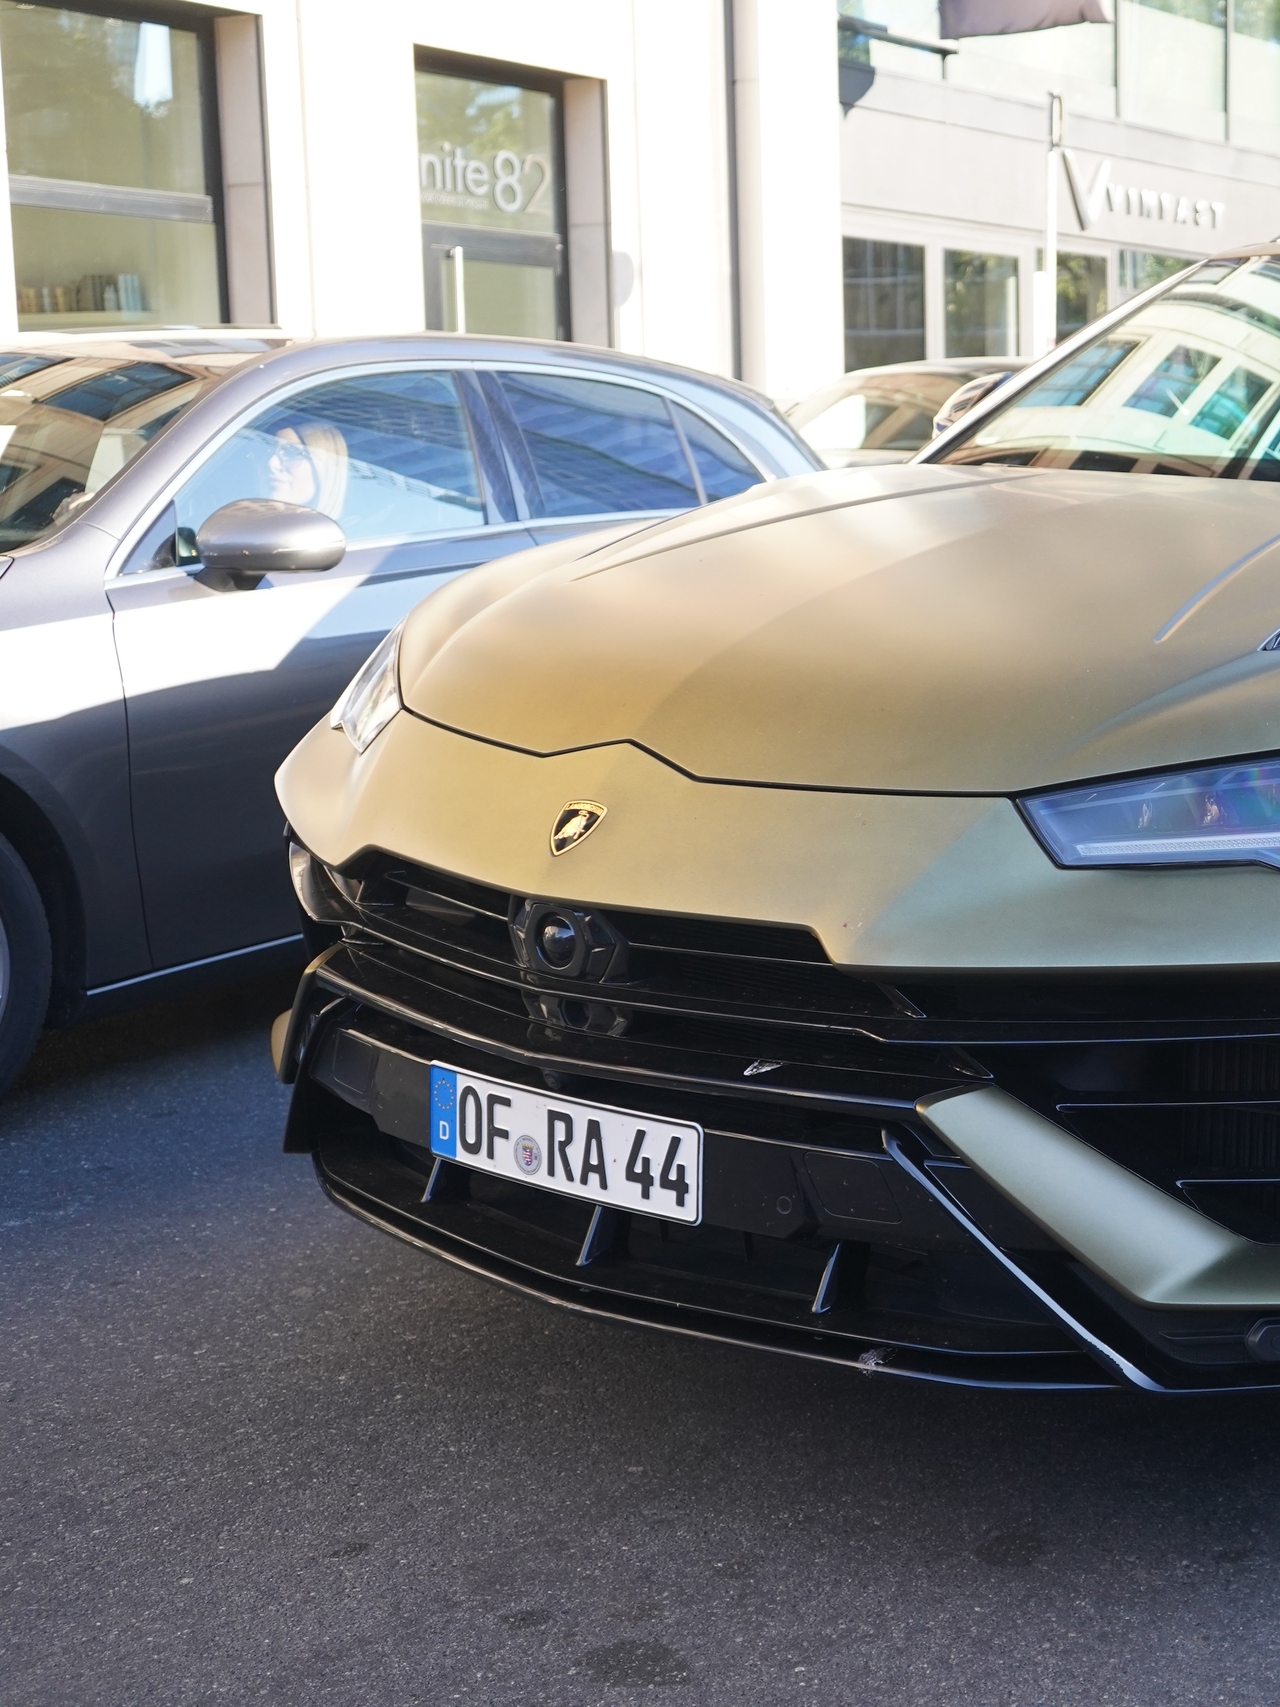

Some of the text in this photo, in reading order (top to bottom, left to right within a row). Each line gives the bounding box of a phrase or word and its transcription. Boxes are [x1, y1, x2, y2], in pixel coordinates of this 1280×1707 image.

[439, 1120, 450, 1140] D
[458, 1085, 511, 1160] OF
[547, 1108, 608, 1191] RA
[625, 1128, 689, 1208] 44
